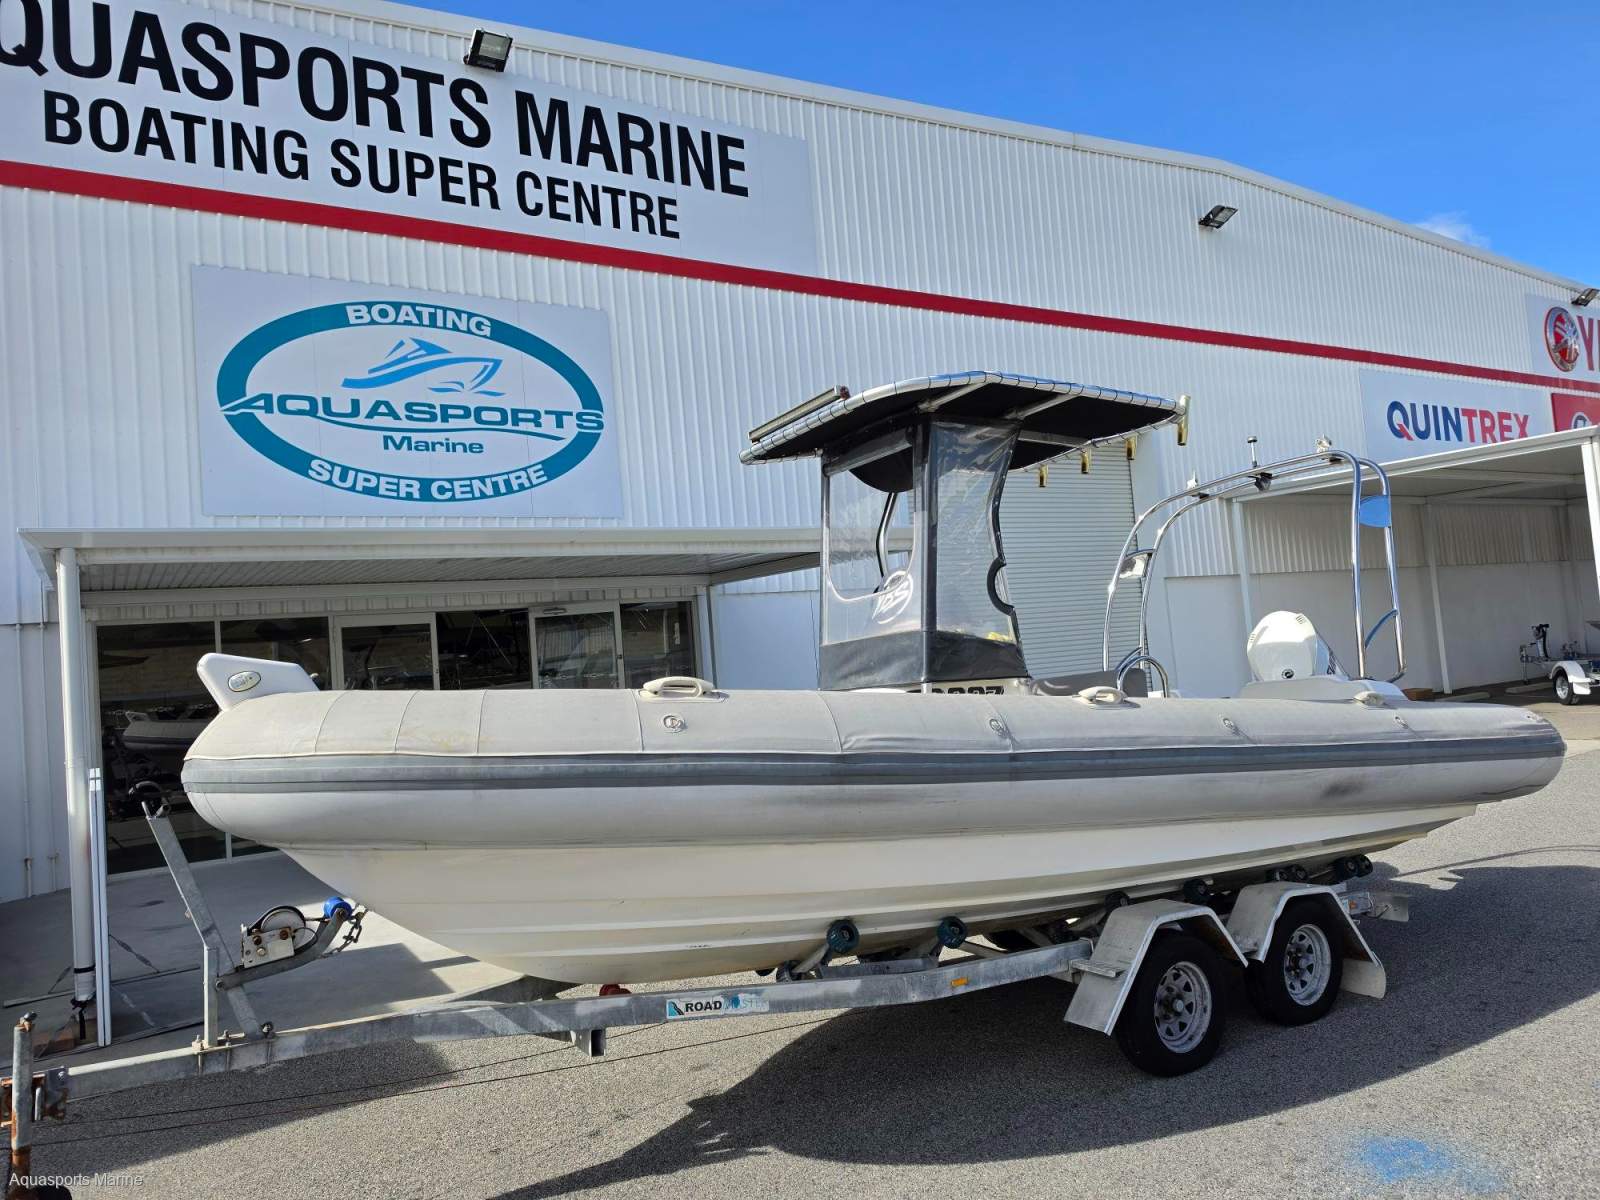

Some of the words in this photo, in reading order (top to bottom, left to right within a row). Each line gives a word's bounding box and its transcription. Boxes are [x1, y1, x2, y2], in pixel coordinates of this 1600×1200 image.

[0, 0, 491, 148] QUASPORTS
[515, 89, 749, 198] MARINE
[43, 89, 309, 181] BOATING
[329, 138, 501, 210] SUPER
[516, 170, 680, 239] CENTRE
[346, 304, 492, 336] BOATING
[1576, 315, 1600, 371] Y
[221, 392, 605, 431] AQUASPORTS
[1387, 401, 1529, 444] QUINTREX
[383, 434, 484, 454] Marine
[308, 459, 421, 500] SUPER
[430, 463, 548, 500] CENTRE
